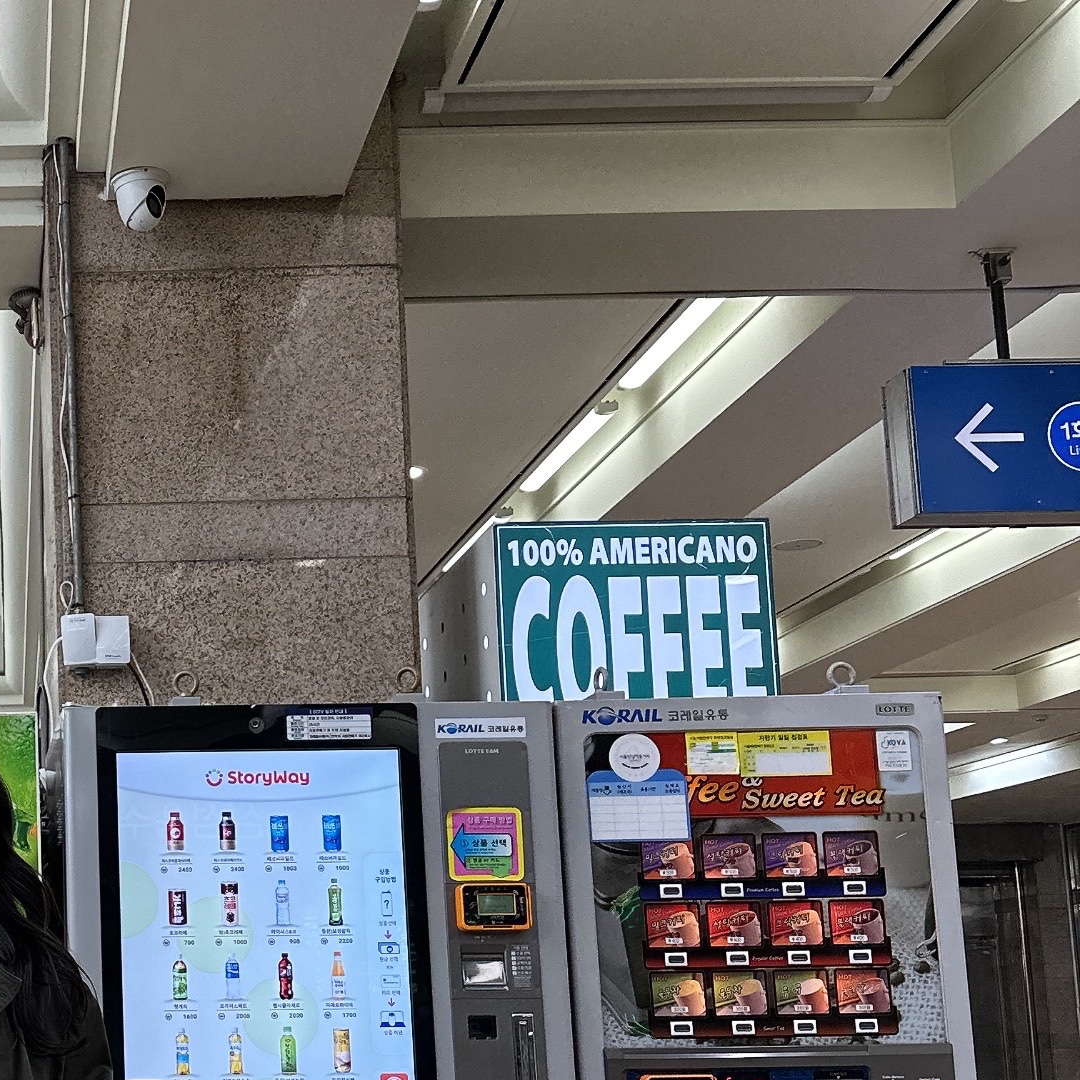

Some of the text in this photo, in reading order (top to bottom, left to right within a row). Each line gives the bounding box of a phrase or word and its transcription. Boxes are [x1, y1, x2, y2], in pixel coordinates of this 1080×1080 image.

[507, 535, 758, 567] 100% AMERICANO
[512, 574, 767, 701] COFFEE
[582, 706, 729, 725] KORAIL 코레일유통
[437, 722, 525, 735] KORAIL 코레일유통
[227, 770, 310, 785] StoryWay
[687, 776, 739, 803] fee
[742, 785, 884, 810] Sweet Tea
[467, 816, 513, 824] 상품 구매 방법
[472, 839, 489, 847] 상품
[491, 839, 507, 847] 선택
